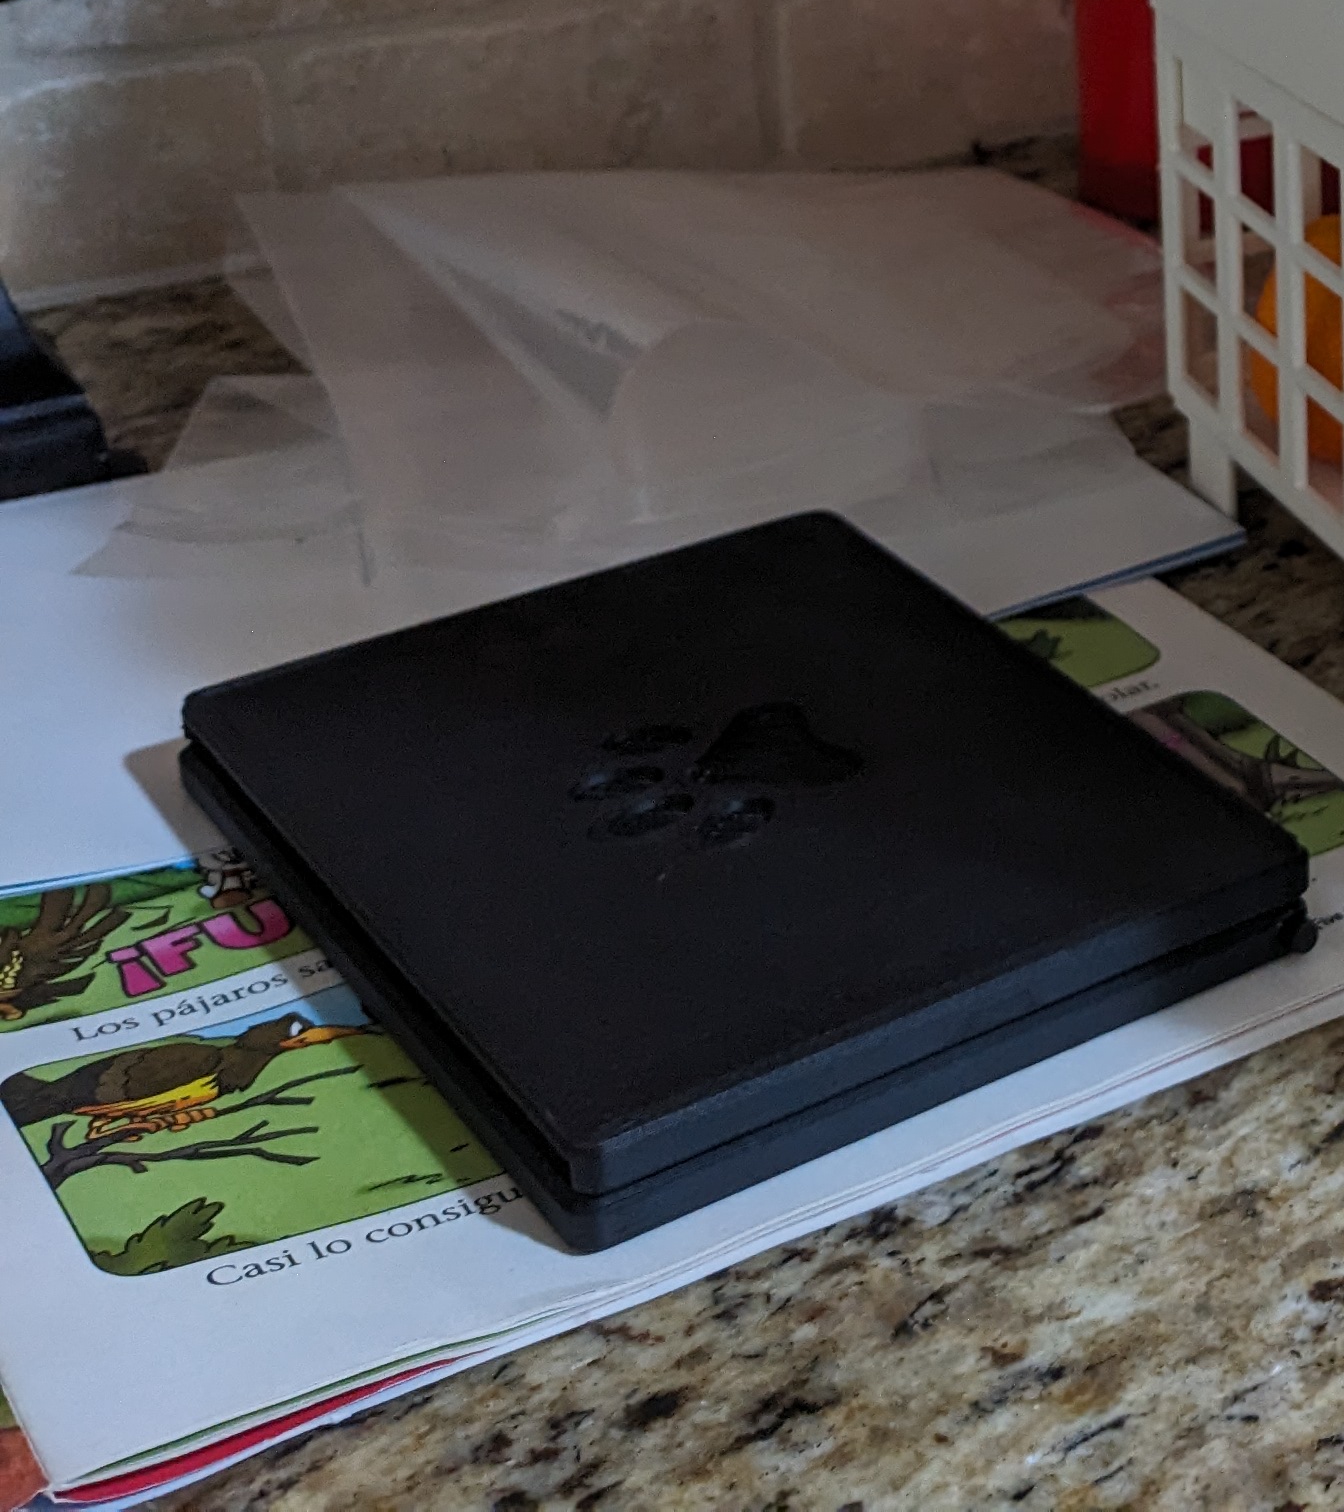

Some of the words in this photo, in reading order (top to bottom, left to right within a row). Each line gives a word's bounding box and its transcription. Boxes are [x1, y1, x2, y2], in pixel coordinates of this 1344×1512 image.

[71, 1015, 140, 1041] Los
[150, 971, 288, 1027] pájaros
[298, 958, 334, 979] sa
[206, 1249, 301, 1286] Casi
[306, 1239, 353, 1261] lo
